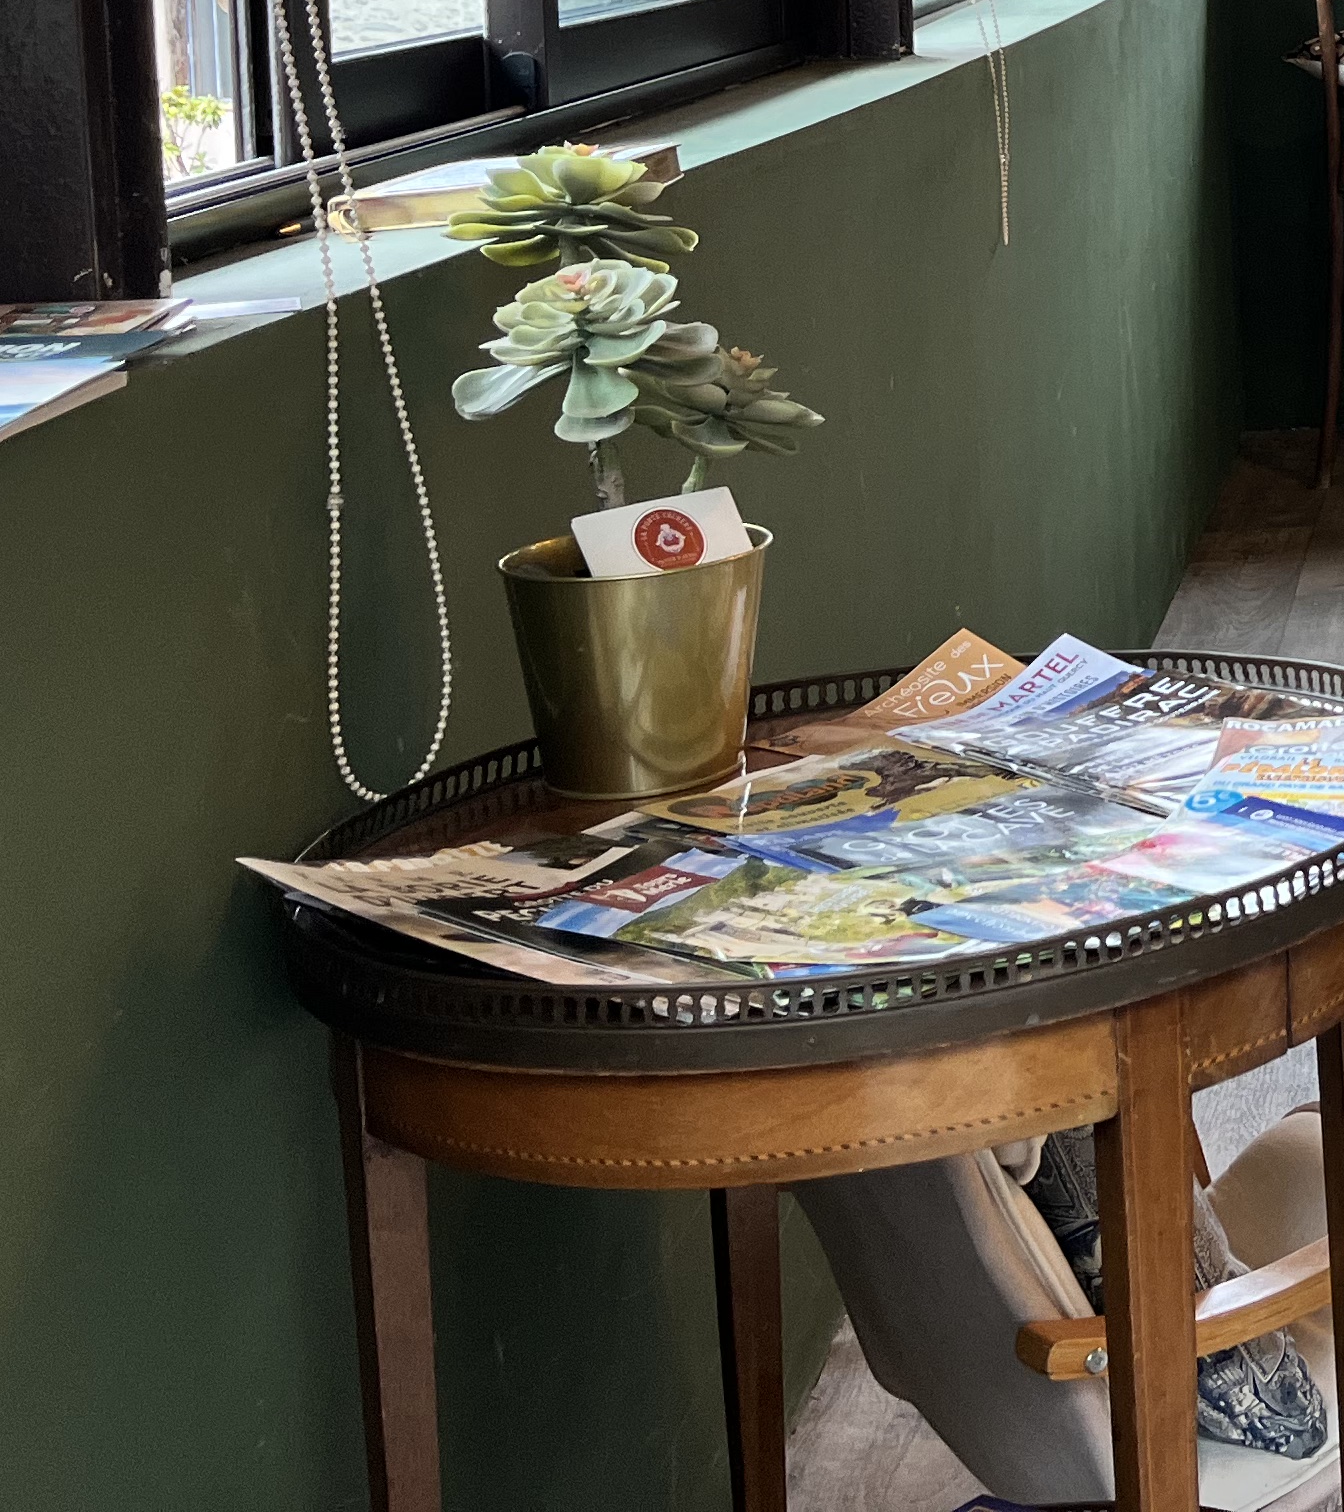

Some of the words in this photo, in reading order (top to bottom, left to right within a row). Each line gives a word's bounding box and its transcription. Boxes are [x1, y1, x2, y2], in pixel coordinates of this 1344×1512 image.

[864, 660, 947, 718] Archéosite
[950, 640, 972, 659] des
[892, 653, 1005, 719] Fieux
[987, 652, 1080, 712] MARTEL
[1057, 657, 1089, 683] QUERCY
[983, 676, 1186, 747] GOUFFRE
